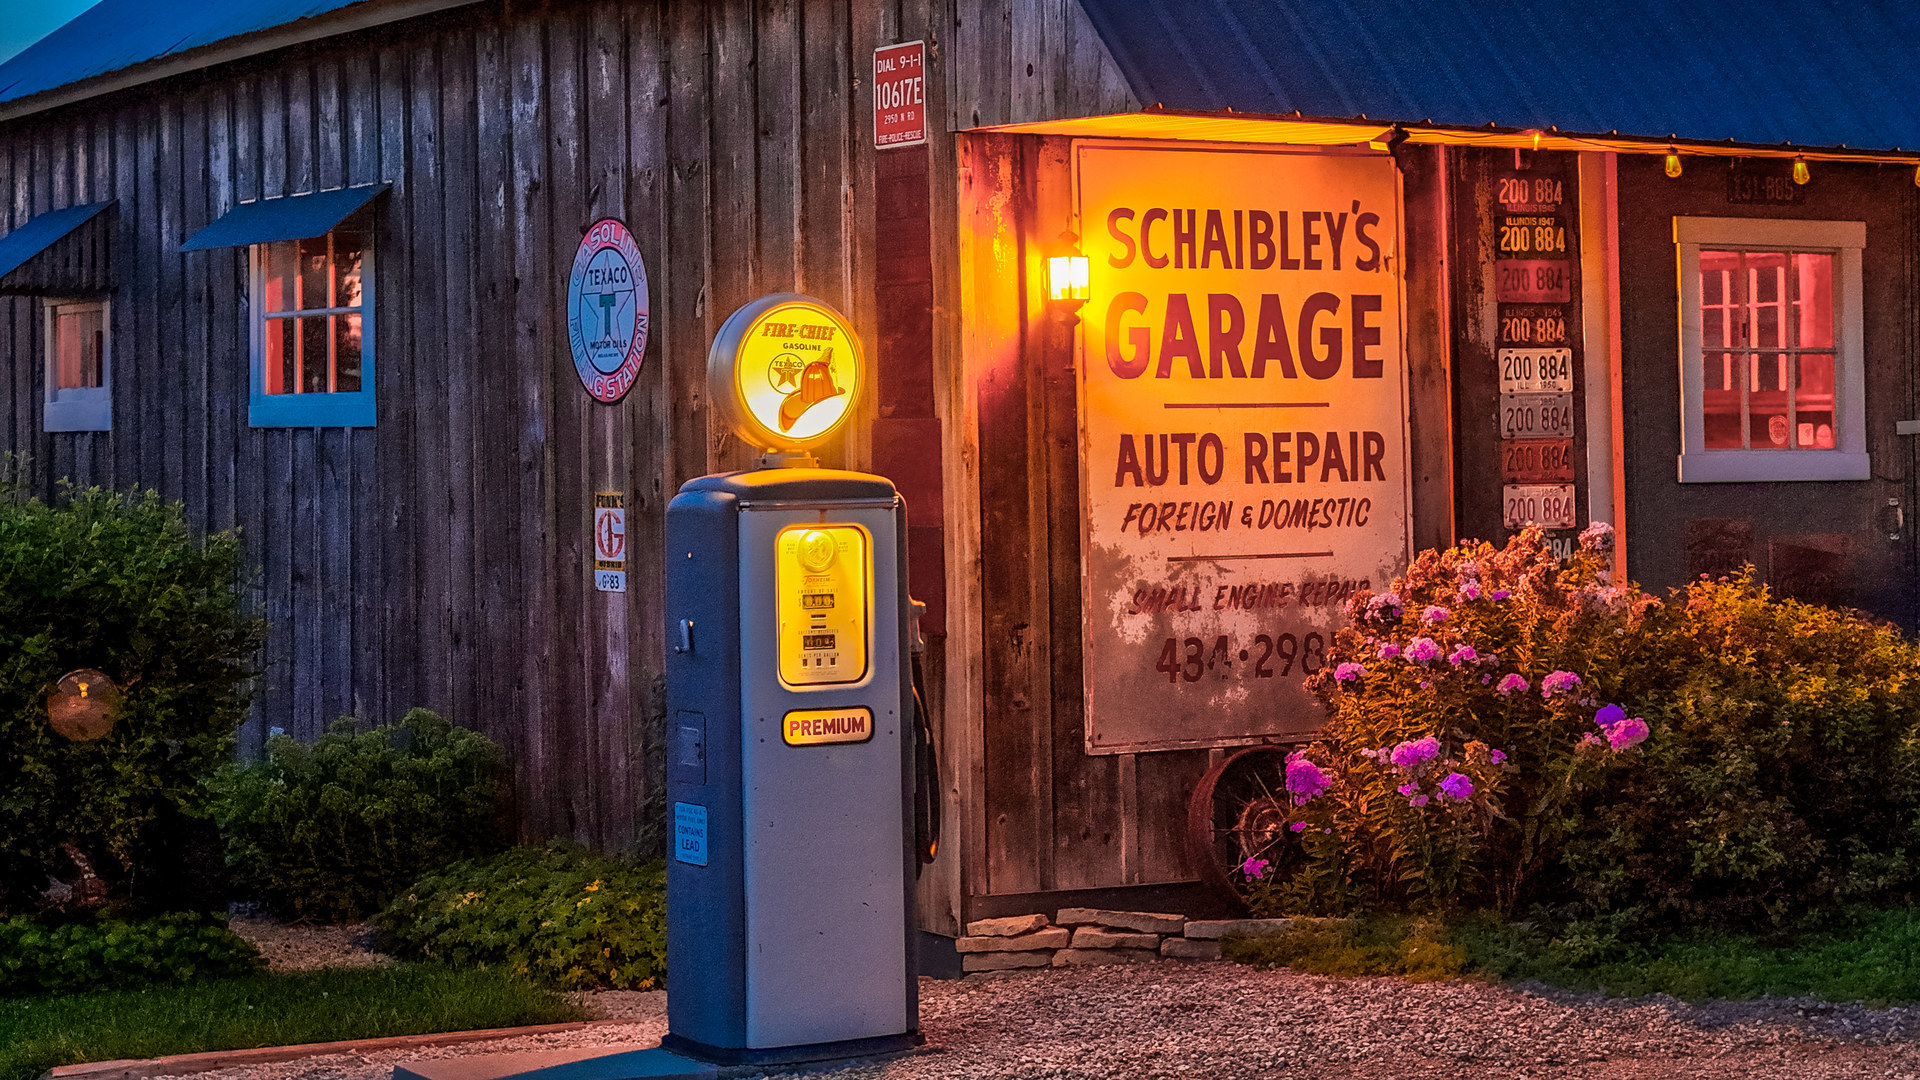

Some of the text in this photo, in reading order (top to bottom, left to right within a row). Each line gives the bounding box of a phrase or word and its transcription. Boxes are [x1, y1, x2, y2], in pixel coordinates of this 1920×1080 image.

[877, 53, 921, 74] DIAL 9-1-1
[876, 77, 922, 110] 10617E
[884, 111, 915, 124] 2950 N RD
[1498, 178, 1562, 205] 200 884
[1506, 204, 1538, 212] ILLINOIS
[1506, 217, 1554, 226] ILLINOIS 1947
[1106, 200, 1381, 273] SCHAIBLEY'S
[1500, 226, 1566, 252] 200 884
[572, 223, 644, 287] GASOLINE
[589, 266, 628, 286] TEXACO
[1502, 267, 1563, 292] 200 884
[1505, 308, 1536, 317] ILLINOIS
[762, 322, 836, 341] FIRE-CHIEF
[1104, 291, 1384, 380] GARAGE
[1502, 318, 1566, 343] 200 884
[570, 313, 648, 399] FILLING STATION
[590, 339, 626, 350] MOTOR OILS
[782, 342, 822, 352] GASOLINE
[774, 360, 803, 368] TEXACO
[1504, 356, 1568, 381] 200 884
[1516, 380, 1556, 390] ILL 1950
[1506, 406, 1570, 432] 200 884
[1114, 430, 1386, 488] AUTO REPAIR
[1506, 446, 1570, 472] 200 884
[1120, 498, 1372, 532] FOREIGN & DOMESTIC
[1508, 497, 1571, 523] 200 884
[1128, 587, 1202, 615] SMALL
[1212, 583, 1294, 610] ENGINE
[790, 716, 865, 736] PREMIUM
[678, 824, 704, 838] CONTAINS
[682, 838, 700, 852] LEAD
